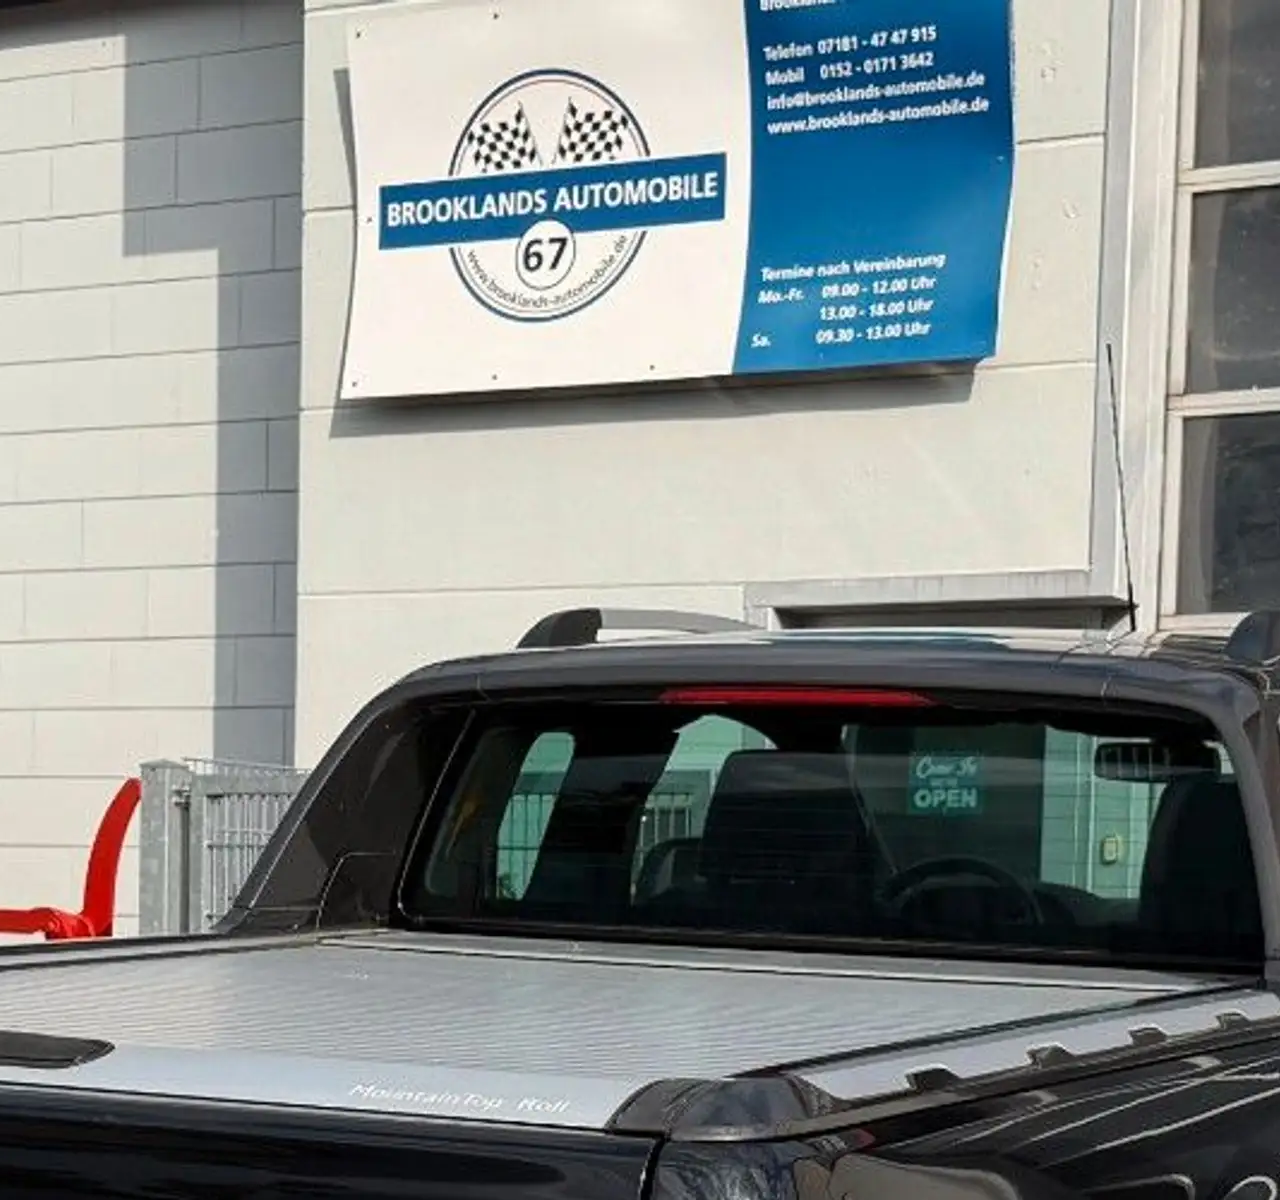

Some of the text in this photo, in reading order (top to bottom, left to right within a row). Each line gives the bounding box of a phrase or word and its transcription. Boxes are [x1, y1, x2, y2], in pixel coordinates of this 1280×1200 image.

[763, 43, 814, 61] Telefon
[817, 36, 858, 54] 07181
[870, 32, 888, 48] 47
[890, 29, 908, 45] 47
[910, 26, 937, 42] 915
[765, 68, 804, 85] Mobil
[820, 61, 852, 79] 0152
[864, 54, 897, 73] 0171
[767, 71, 985, 111] info@brooklands-automobile.de
[767, 97, 989, 134] www.brooklands-automobile.de
[387, 172, 719, 227] BROOKLANDS AUTOMOBILE
[467, 234, 628, 308] www.brooklands-automobile.de
[522, 237, 568, 273] 67
[761, 253, 946, 281] Termine nach Vereinbarung
[872, 277, 907, 294] 12.00
[911, 275, 937, 290] Uhr
[820, 304, 856, 321] 13.00
[908, 299, 934, 313] Uhr
[815, 327, 854, 345] 09.30
[866, 324, 902, 340] 13.00
[905, 322, 932, 336] Uhr
[914, 787, 978, 808] OPEN
